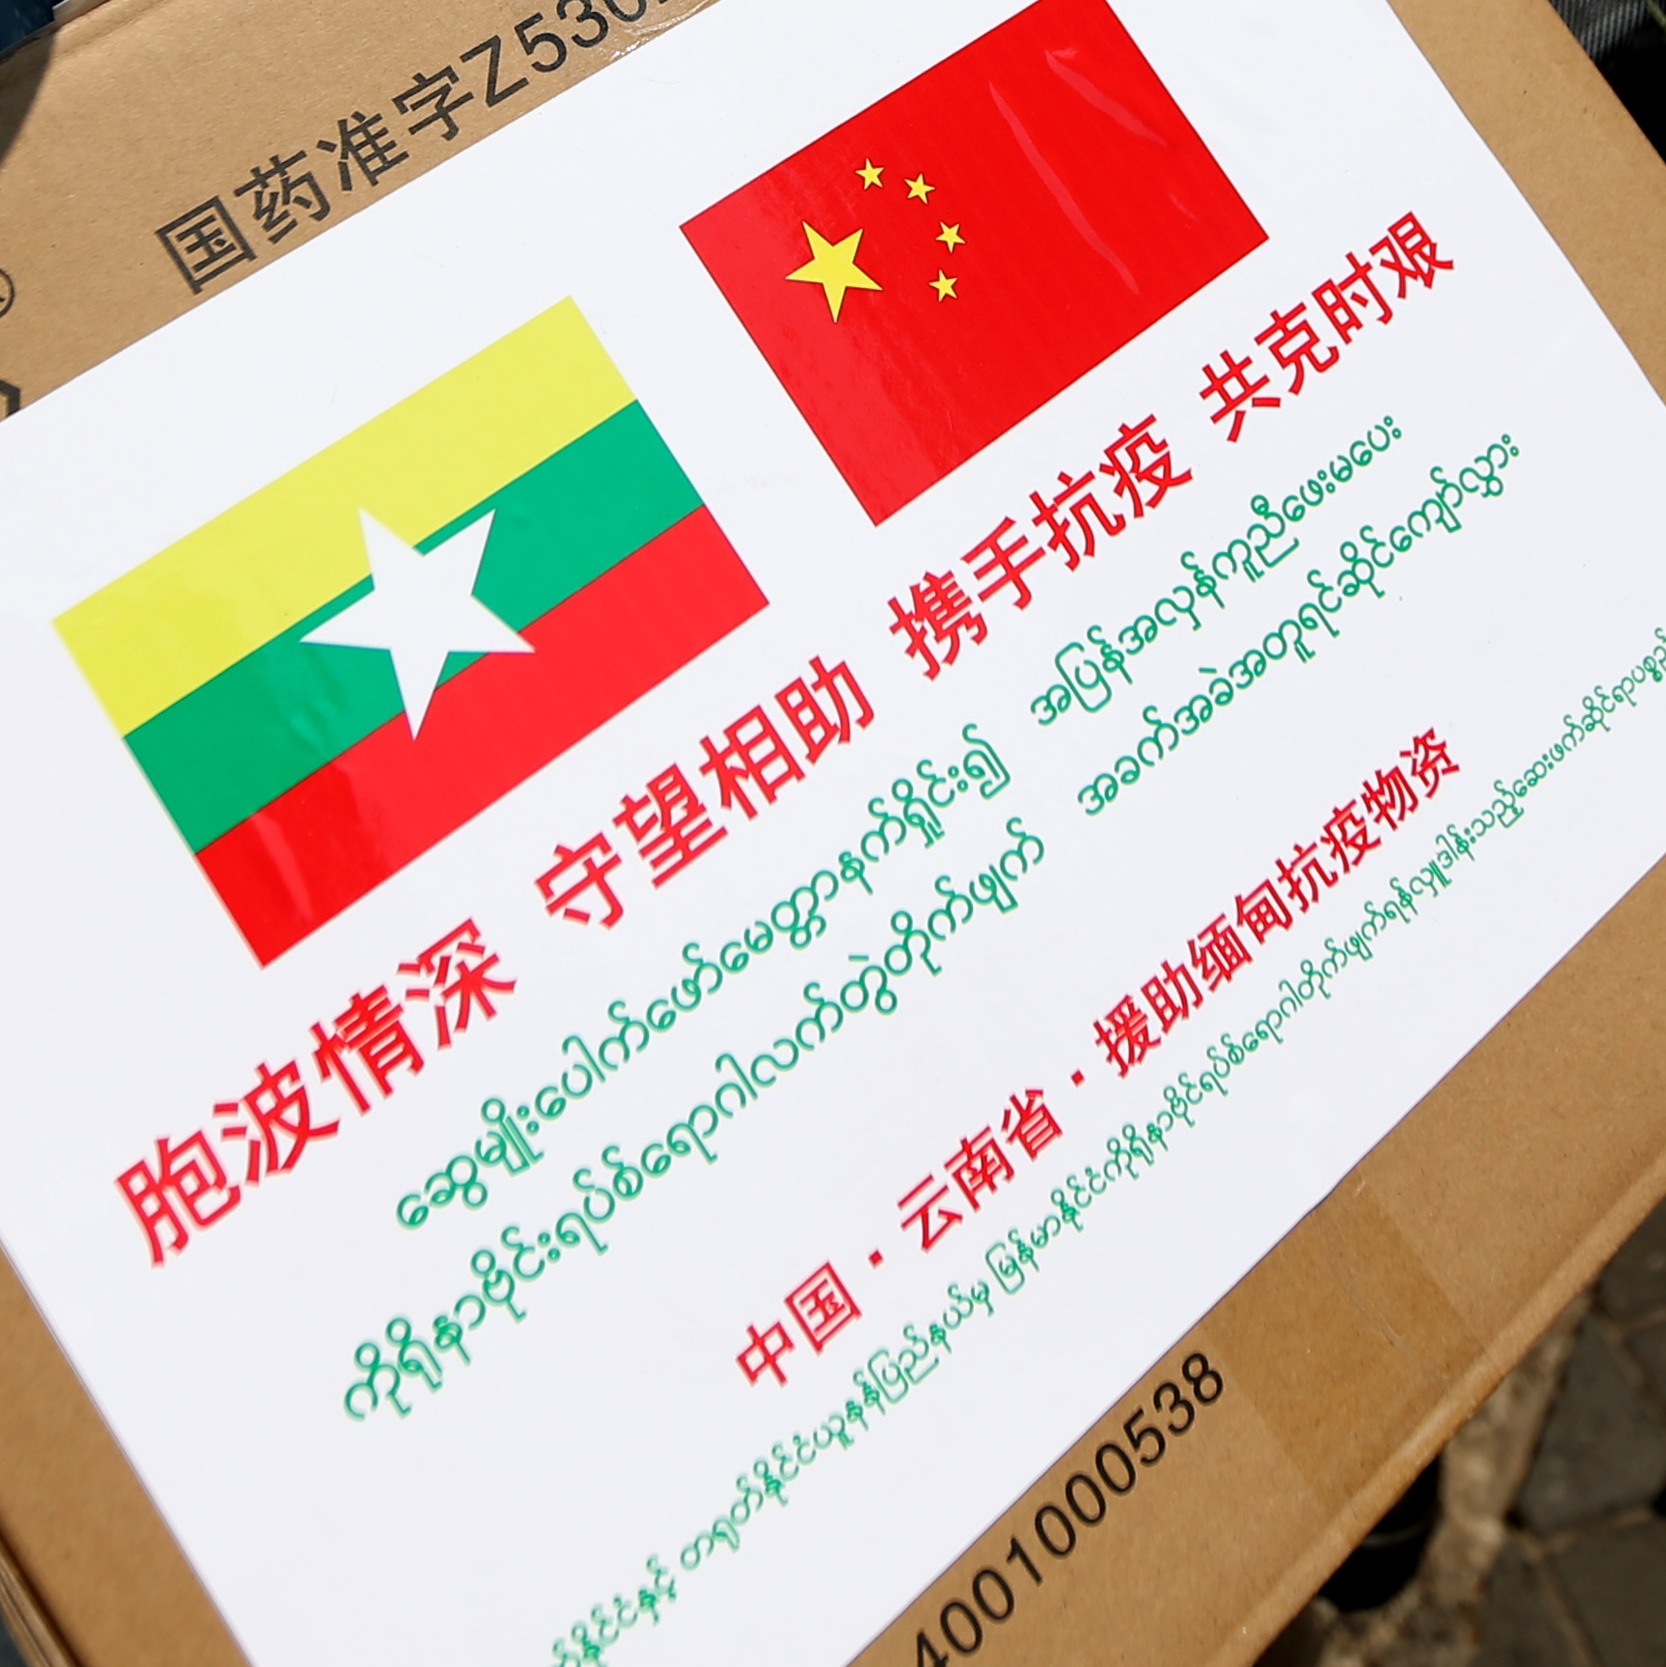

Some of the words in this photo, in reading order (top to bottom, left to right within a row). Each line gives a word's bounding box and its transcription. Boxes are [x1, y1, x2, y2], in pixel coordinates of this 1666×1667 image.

[117, 919, 517, 1266] 胞波情深
[536, 656, 875, 928] 守望相助
[888, 414, 1194, 680] 携手抗疫
[1200, 212, 1455, 442] 共克时艰
